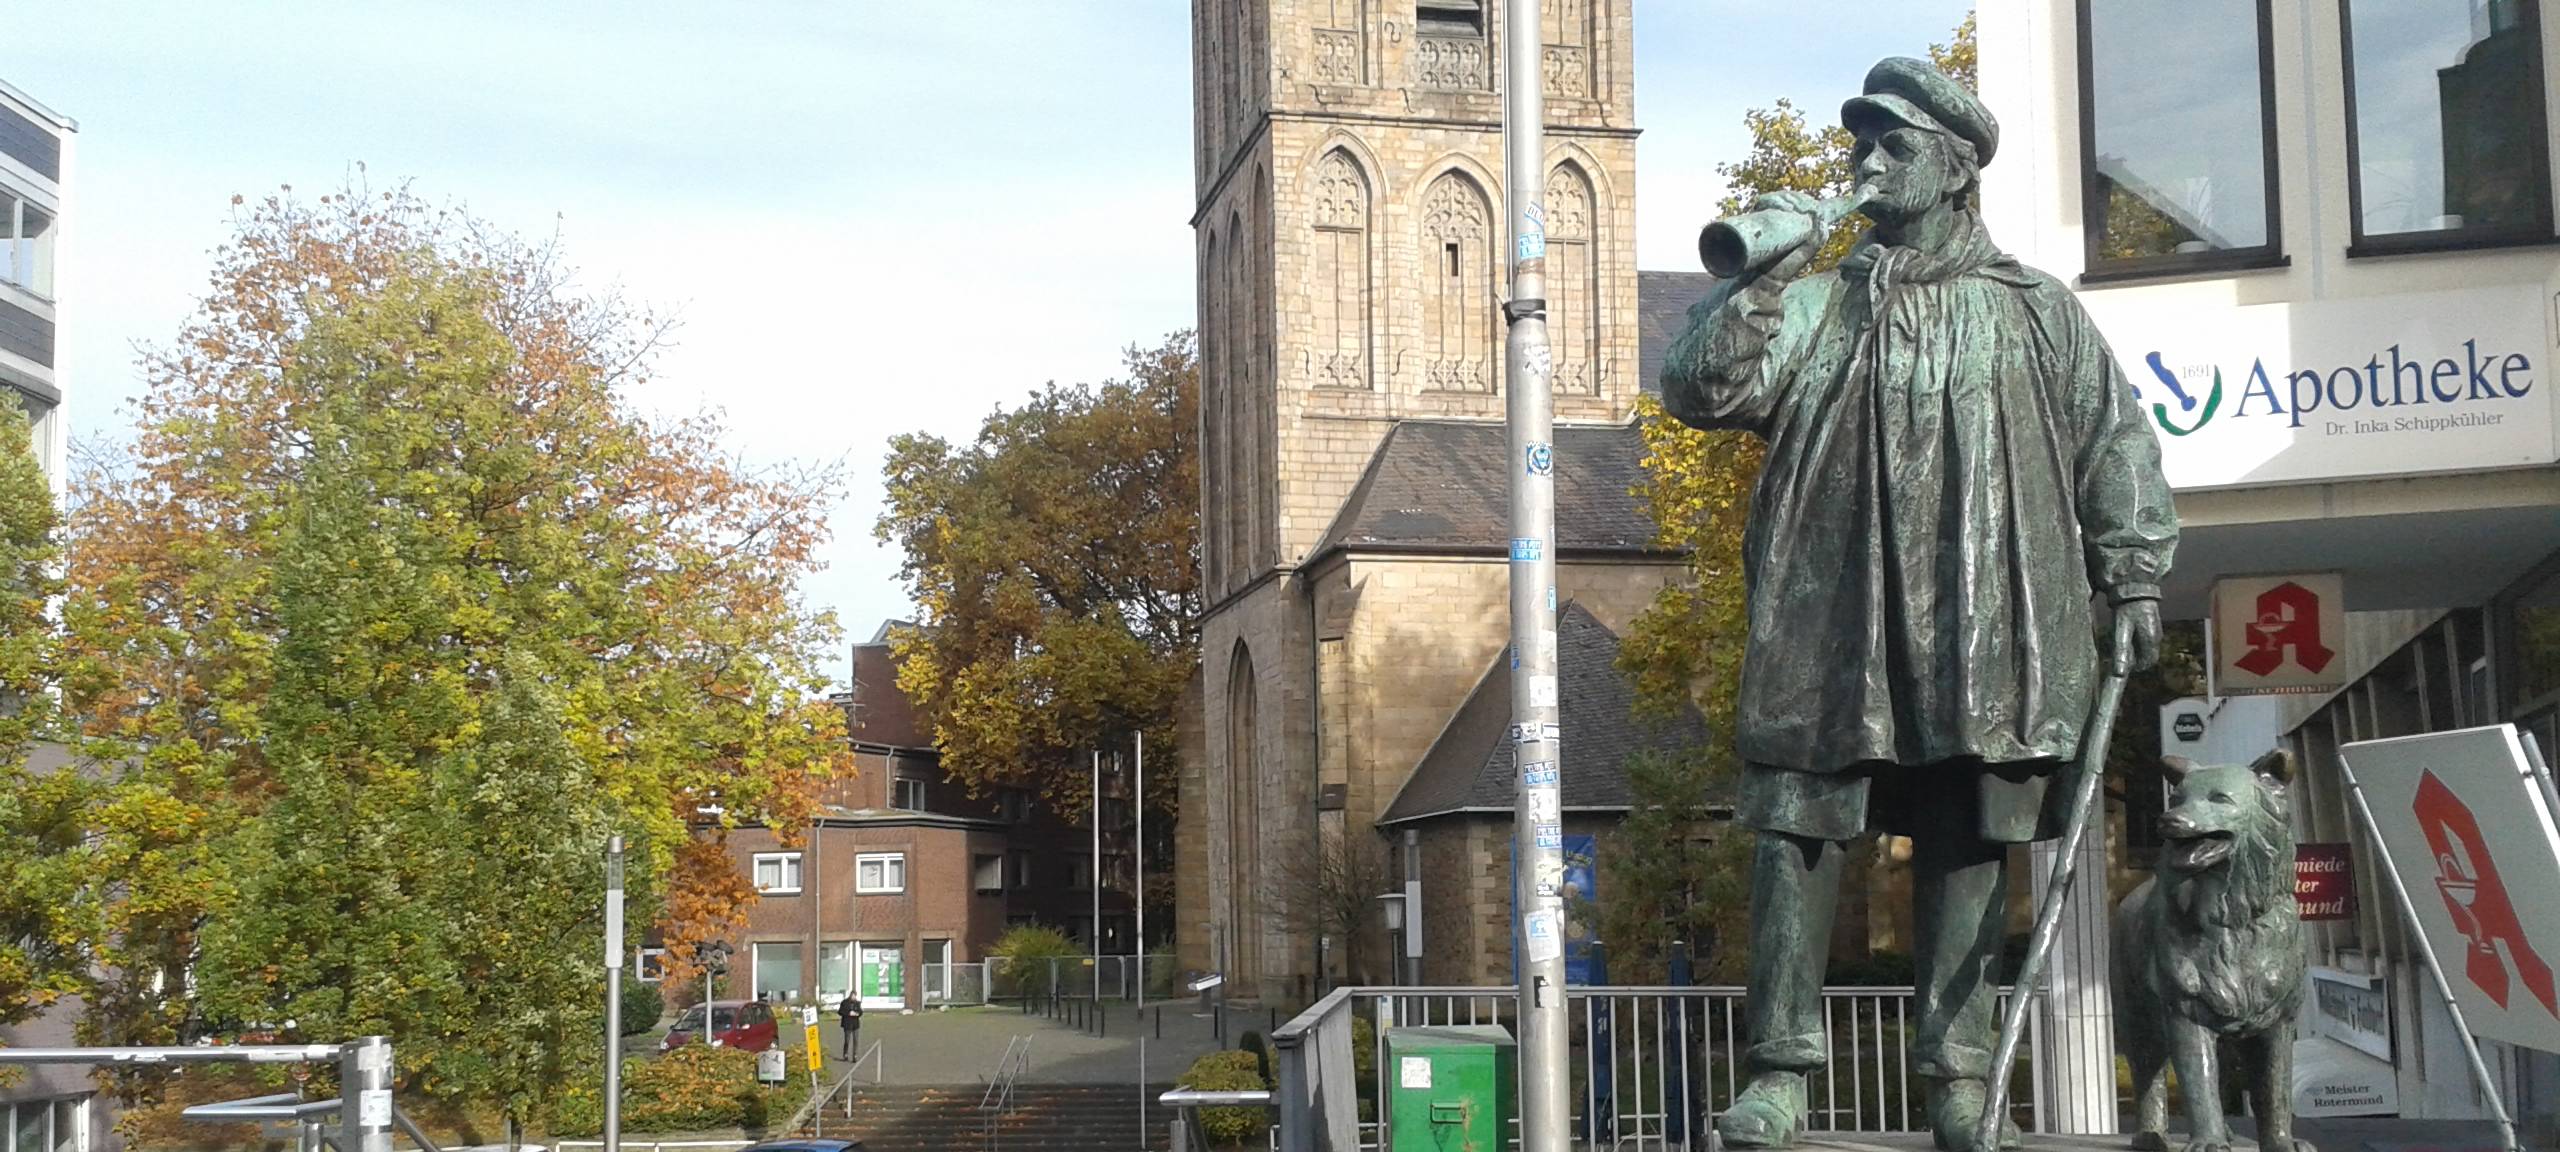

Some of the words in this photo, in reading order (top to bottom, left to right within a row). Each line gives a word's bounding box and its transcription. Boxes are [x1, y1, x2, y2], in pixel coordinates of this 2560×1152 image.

[2182, 364, 2211, 379] 1691
[2231, 338, 2534, 428] Apotheke
[2325, 421, 2349, 436] Dr.
[2354, 419, 2390, 434] Inka
[2394, 411, 2504, 432] Schippkühler
[2324, 1084, 2370, 1095] Meister
